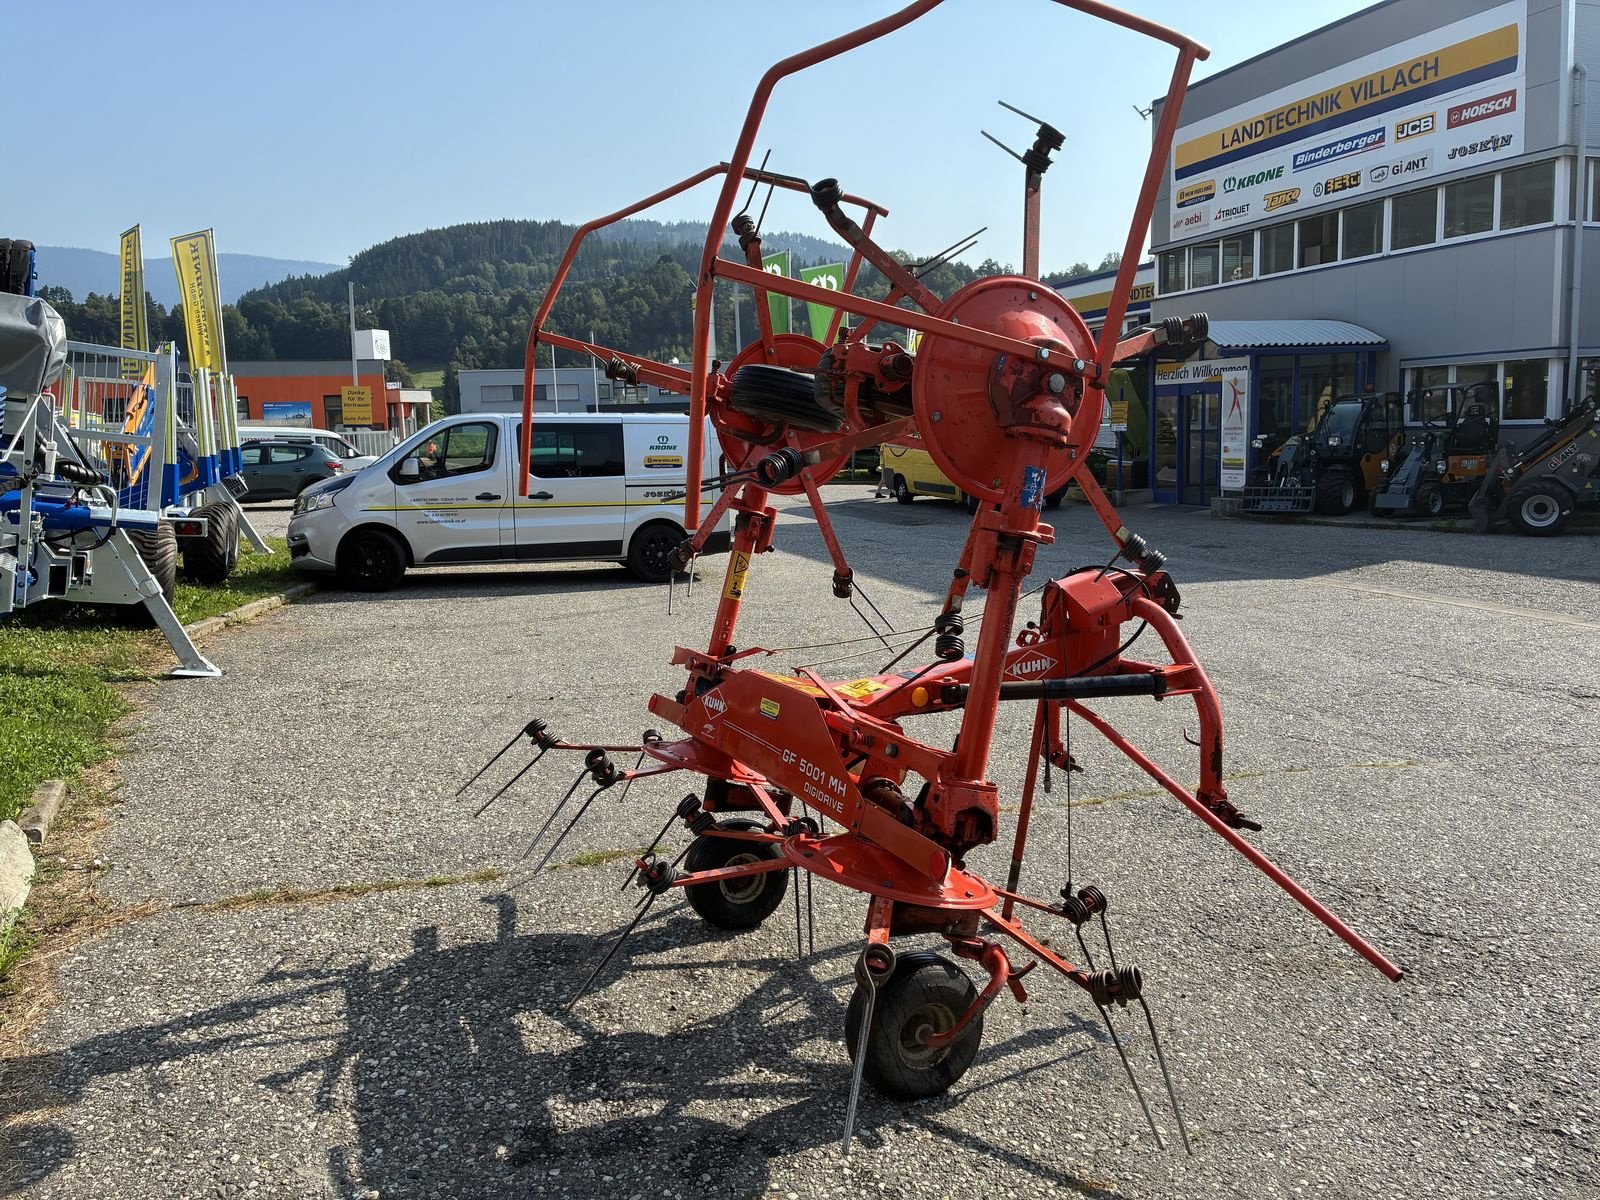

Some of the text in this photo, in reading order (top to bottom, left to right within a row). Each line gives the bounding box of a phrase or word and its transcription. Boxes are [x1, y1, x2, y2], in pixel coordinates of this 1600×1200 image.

[1221, 56, 1439, 150] LANDTECHNIK VILLACH
[1461, 95, 1512, 121] HORSCH
[1397, 116, 1433, 139] JCB
[1295, 131, 1383, 166] Binderberger
[1447, 133, 1513, 160] JOSKIN
[1236, 165, 1285, 190] KRONE
[1264, 188, 1301, 212] Tanco
[1184, 212, 1202, 226] aebi
[1157, 367, 1189, 381] Herzlich
[1012, 657, 1051, 677] KUHN
[703, 695, 725, 713] KUHN
[782, 748, 847, 797] GF 5001 MH
[803, 782, 844, 814] DIGIDRIVE
